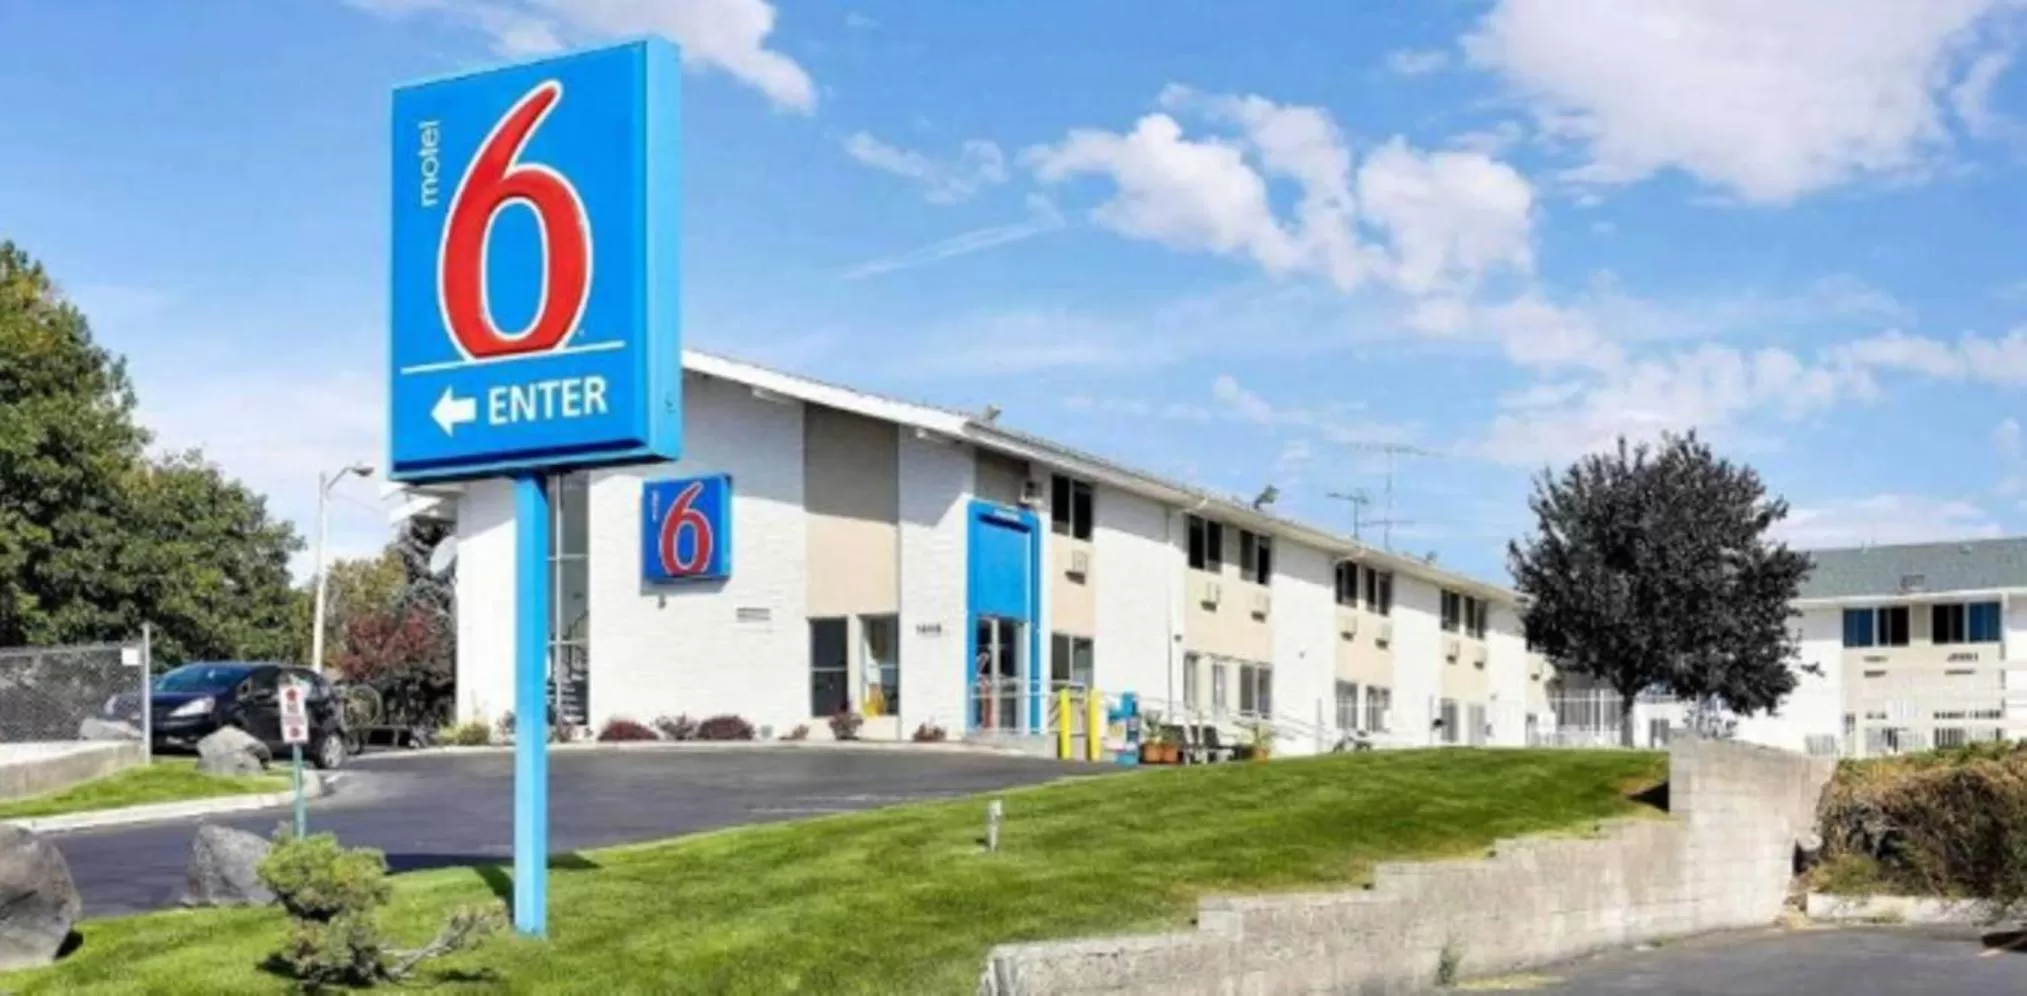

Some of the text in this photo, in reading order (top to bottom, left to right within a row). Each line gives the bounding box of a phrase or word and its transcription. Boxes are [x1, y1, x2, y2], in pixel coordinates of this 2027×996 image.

[418, 121, 440, 207] motel
[437, 80, 593, 362] 6
[488, 376, 608, 425] ENTER
[658, 481, 713, 577] 6
